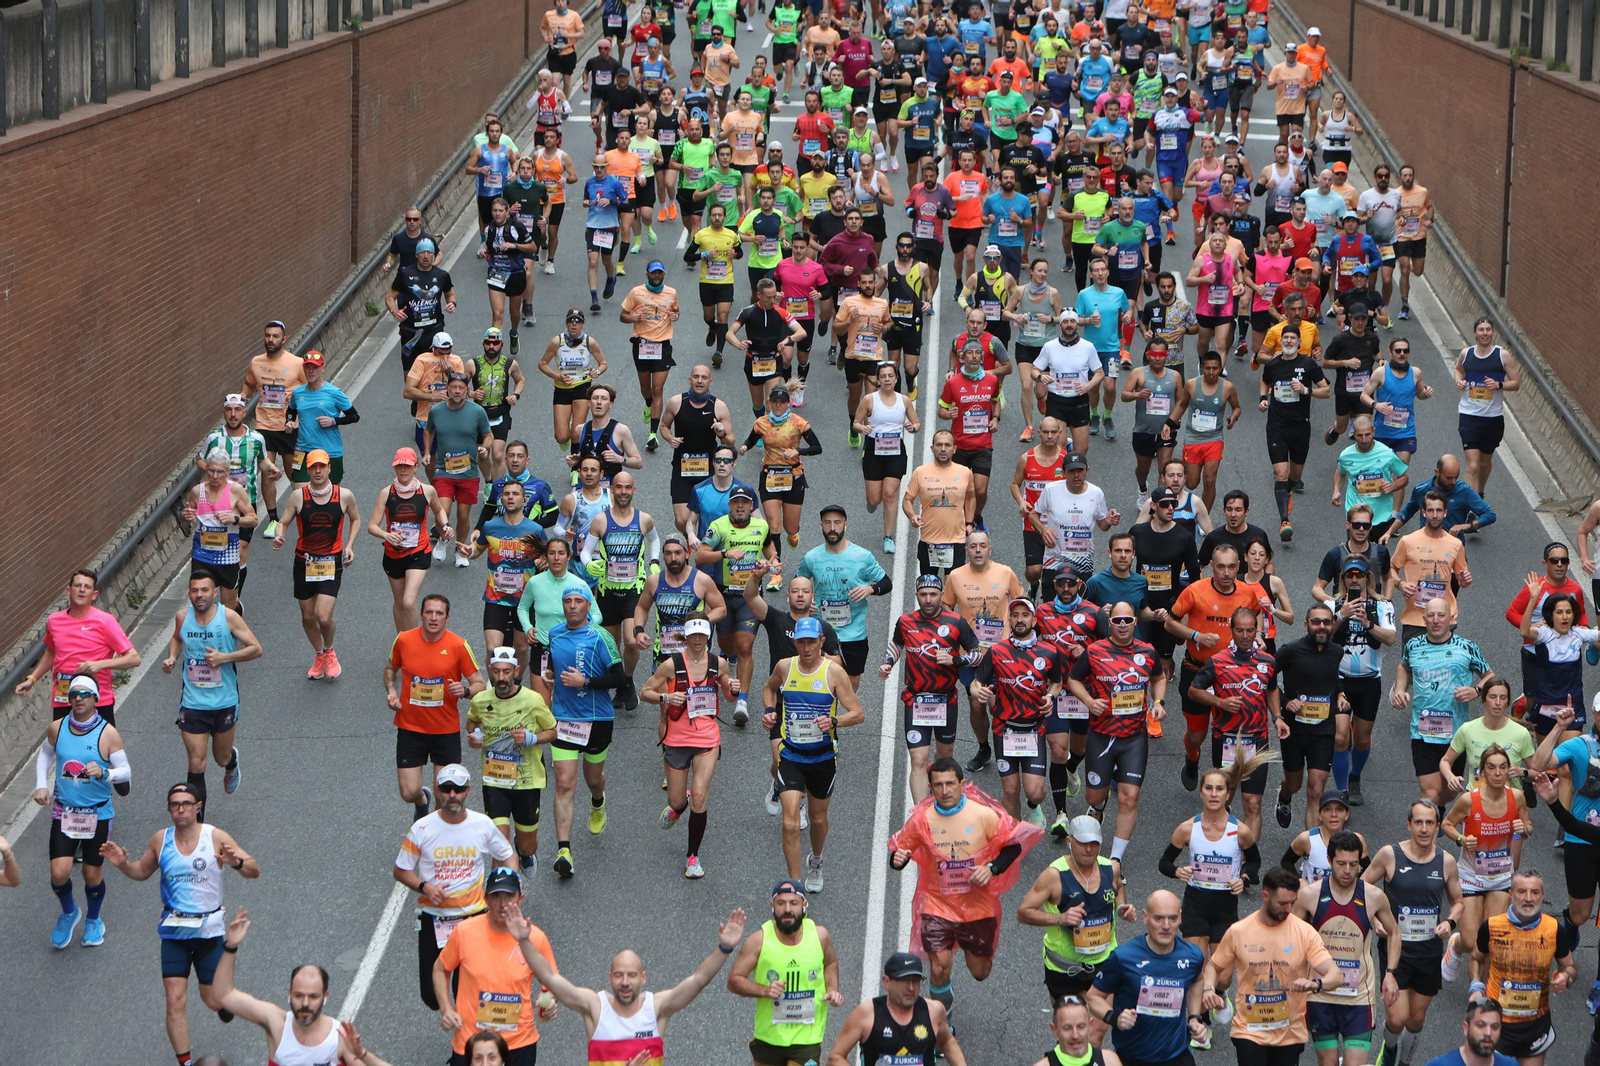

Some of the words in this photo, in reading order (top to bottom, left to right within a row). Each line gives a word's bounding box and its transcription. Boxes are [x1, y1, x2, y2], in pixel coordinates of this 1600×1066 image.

[187, 630, 214, 640] nerja
[433, 845, 477, 859] GRAN
[433, 859, 476, 868] CANARIA
[493, 993, 519, 1002] ZURICH
[896, 1056, 919, 1065] ZURICH
